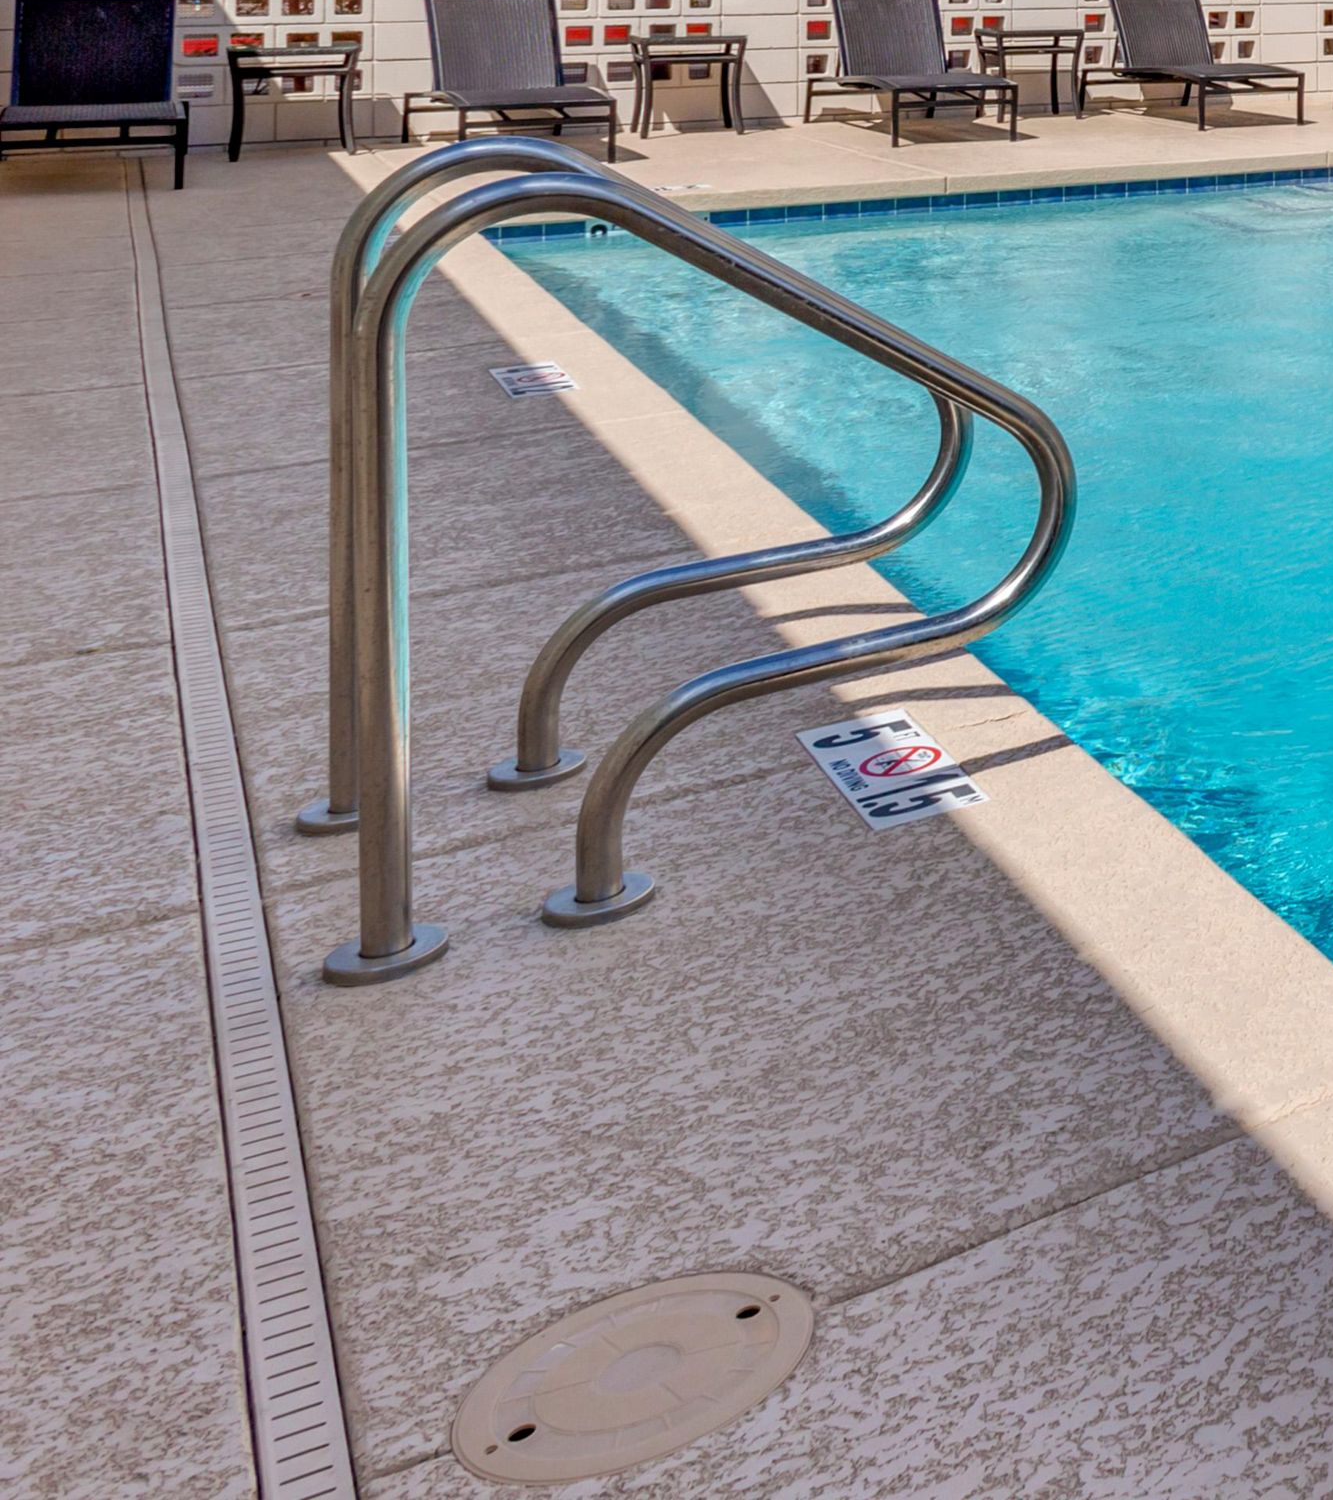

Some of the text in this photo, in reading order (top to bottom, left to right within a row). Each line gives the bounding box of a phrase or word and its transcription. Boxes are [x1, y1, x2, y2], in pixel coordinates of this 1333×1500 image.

[812, 719, 912, 749] 5
[829, 758, 869, 792] NO DIVING
[855, 772, 977, 818] 1.5
